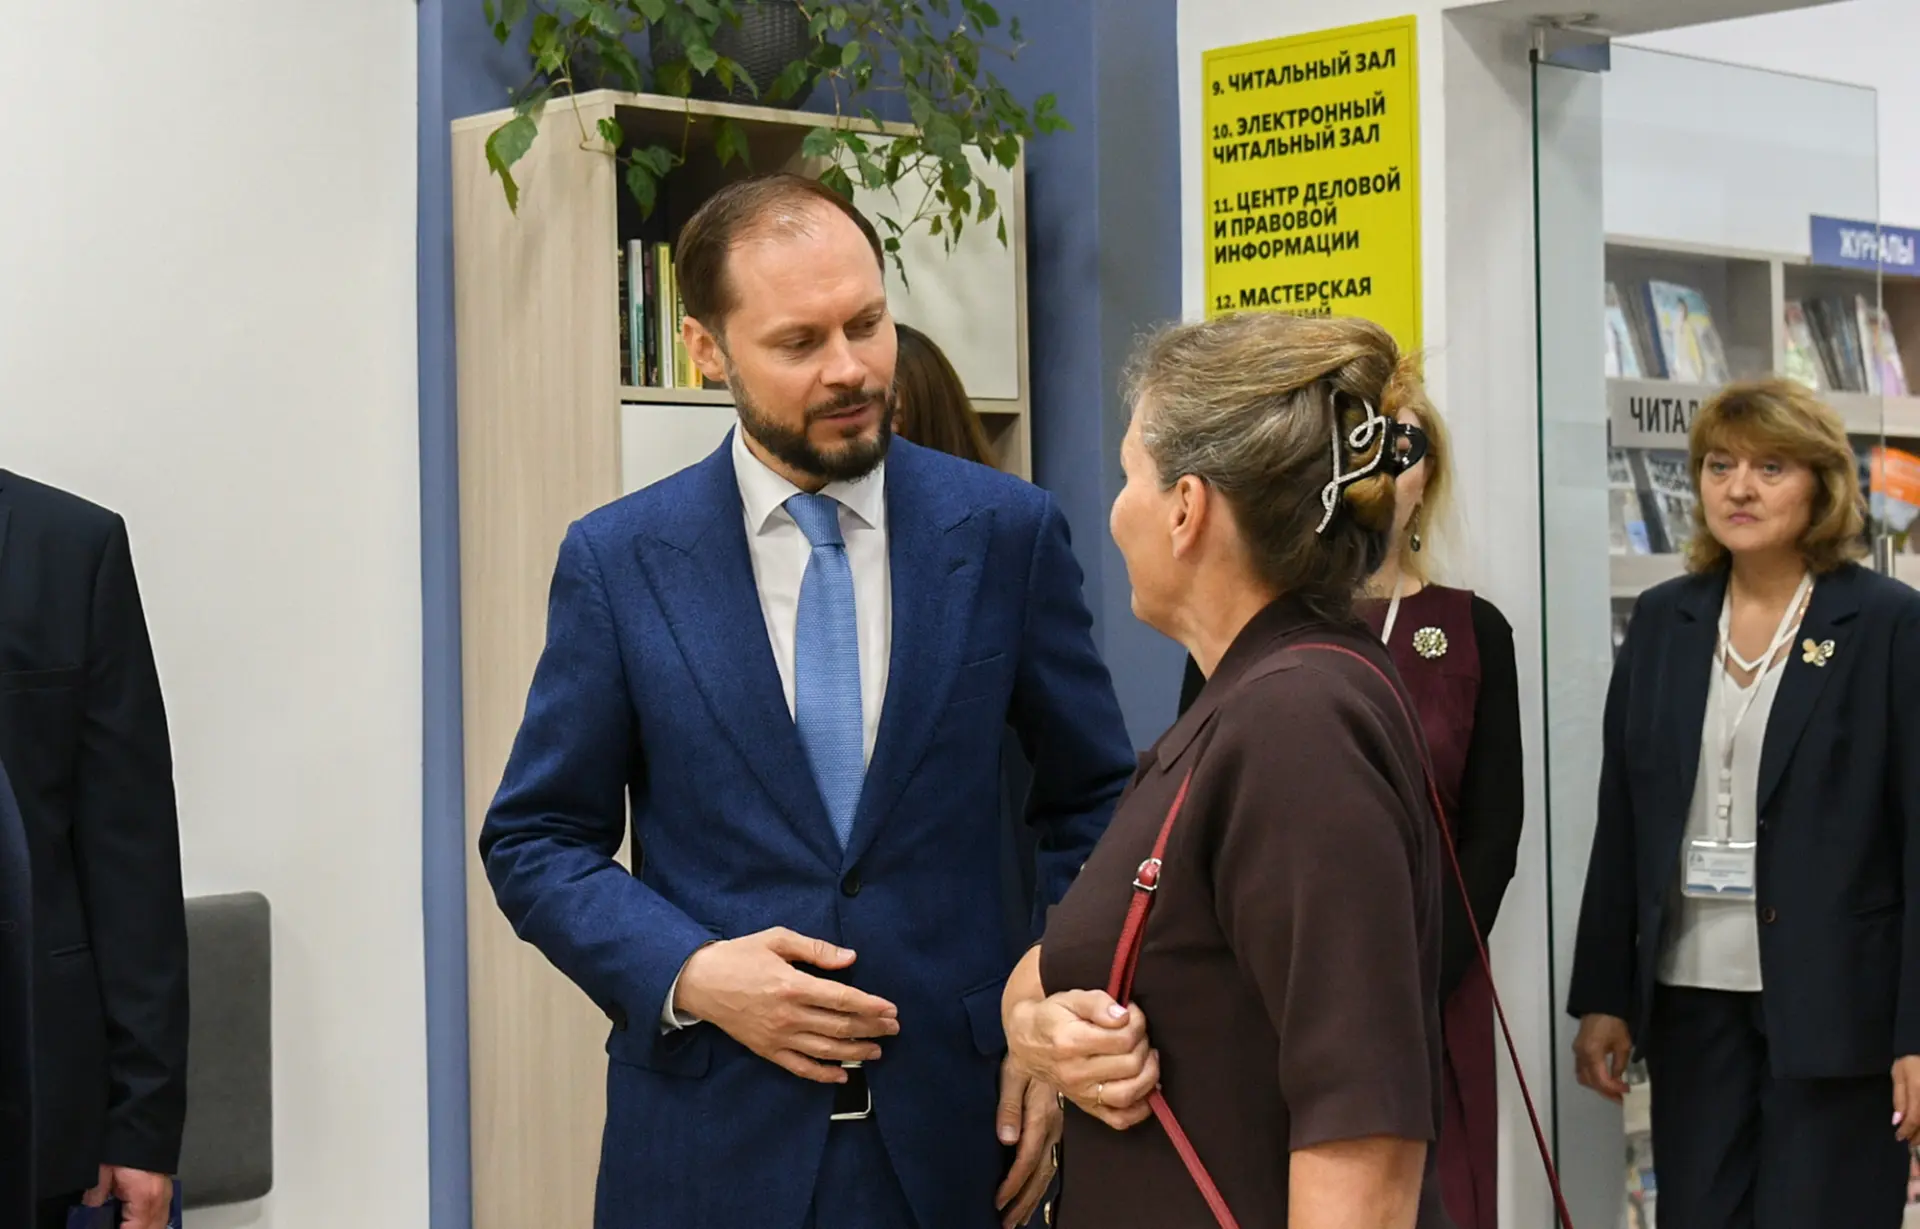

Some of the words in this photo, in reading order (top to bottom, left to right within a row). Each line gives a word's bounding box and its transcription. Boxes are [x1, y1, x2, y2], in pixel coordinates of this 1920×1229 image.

[1212, 81, 1224, 96] 9.
[1228, 50, 1351, 92] ЧИТАЛЬНЫЙ
[1355, 48, 1396, 73] ЗАЛ
[1213, 124, 1233, 140] 10.
[1236, 90, 1386, 136] ЭЛЕКТРОННЫЙ
[1213, 124, 1335, 164] ЧИТАЛЬНЫЙ
[1339, 123, 1380, 147] ЗАЛ
[1214, 199, 1233, 214] 11.
[1237, 185, 1299, 214] ЦЕНТР
[1303, 166, 1400, 207] ДЕЛОВОЙ
[1214, 220, 1226, 239] И
[1231, 201, 1337, 237] ПРАВОВОЙ
[1215, 230, 1359, 265] ИНФОРМАЦИИ
[1216, 295, 1235, 310] 12.
[1240, 276, 1371, 307] МАСТЕРСКАЯ
